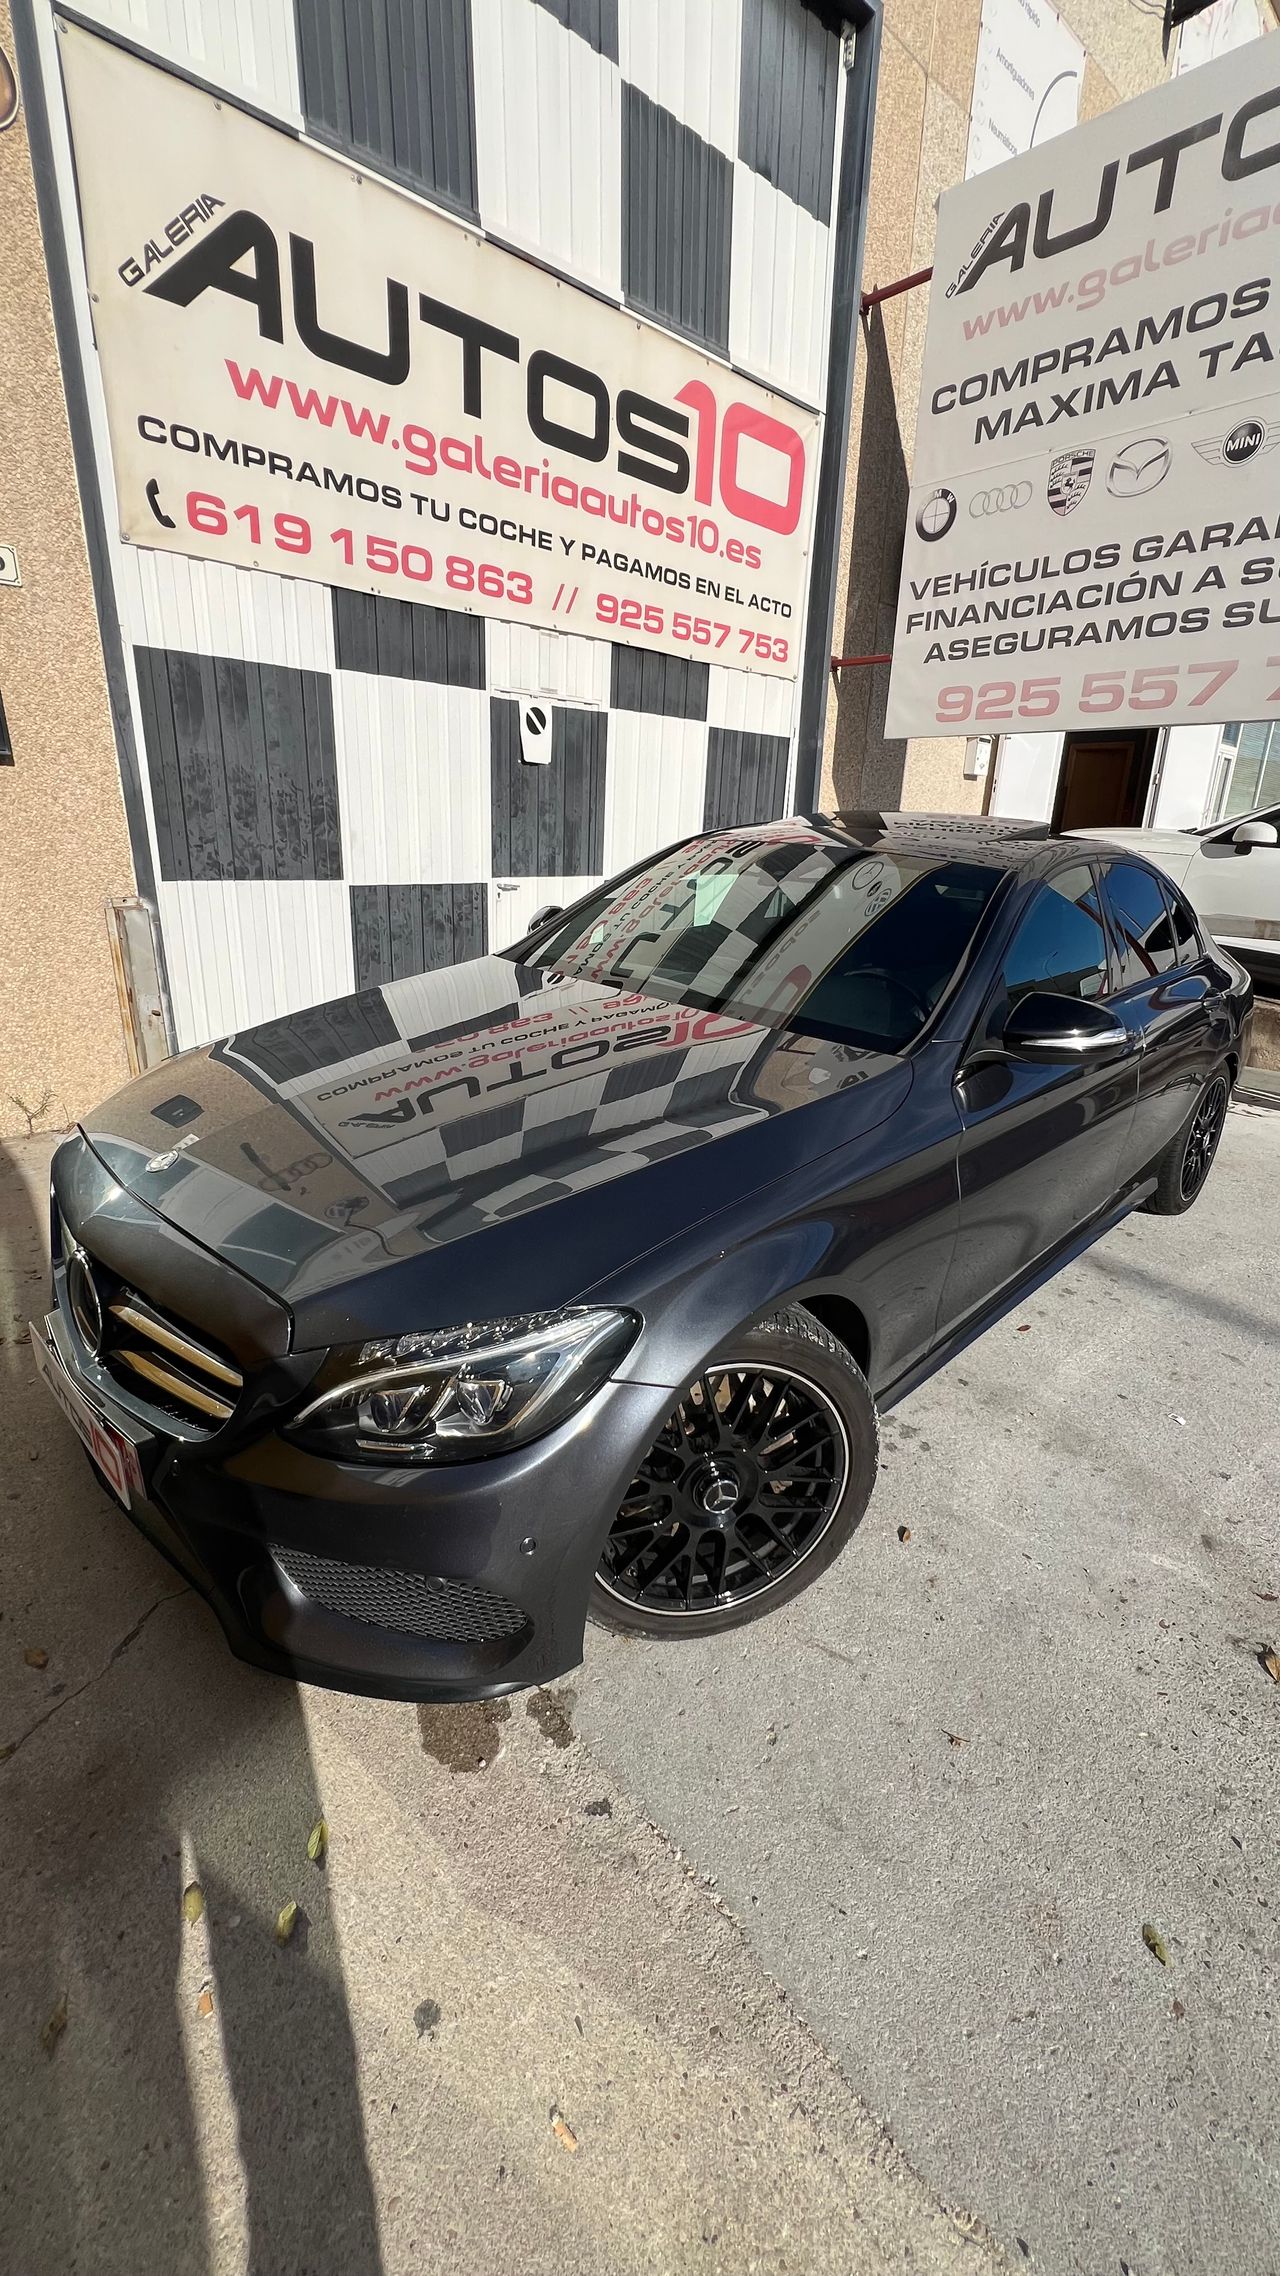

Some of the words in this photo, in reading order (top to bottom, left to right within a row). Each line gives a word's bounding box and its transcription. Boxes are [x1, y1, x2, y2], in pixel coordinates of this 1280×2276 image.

[118, 193, 226, 288] GALERIA
[944, 211, 1006, 300] GALERIA
[962, 203, 1280, 342] www.galeria
[143, 209, 806, 536] AUTOS10
[930, 277, 1272, 416] COMPRAMOS
[973, 359, 1181, 445] MAXIMA
[1198, 331, 1280, 379] TA
[224, 358, 762, 570] www.galeriaautos10.es
[1226, 433, 1261, 452] MINI
[137, 414, 402, 510] COMPRAMOS
[410, 492, 450, 522] TU
[458, 508, 553, 552] COCHE
[559, 536, 576, 557] Y
[582, 542, 692, 591] PAGAMOS
[696, 578, 721, 600] EN
[724, 586, 745, 606] EL
[748, 594, 793, 619] ACTO
[909, 542, 1122, 601] VEHÍCULOS
[1132, 513, 1280, 563] GARA
[186, 490, 313, 555] 619
[331, 527, 433, 584] 150
[445, 555, 534, 605] 863
[551, 583, 579, 615] //
[595, 593, 665, 635] 925
[671, 612, 731, 649] 557
[738, 627, 789, 663] 753
[905, 570, 1184, 634] FINANCIACIÓN
[1191, 565, 1227, 594] A
[1240, 557, 1280, 586] S
[922, 607, 1211, 664] ASEGURAMOS
[935, 676, 1062, 724] 925
[1078, 659, 1240, 714] 557
